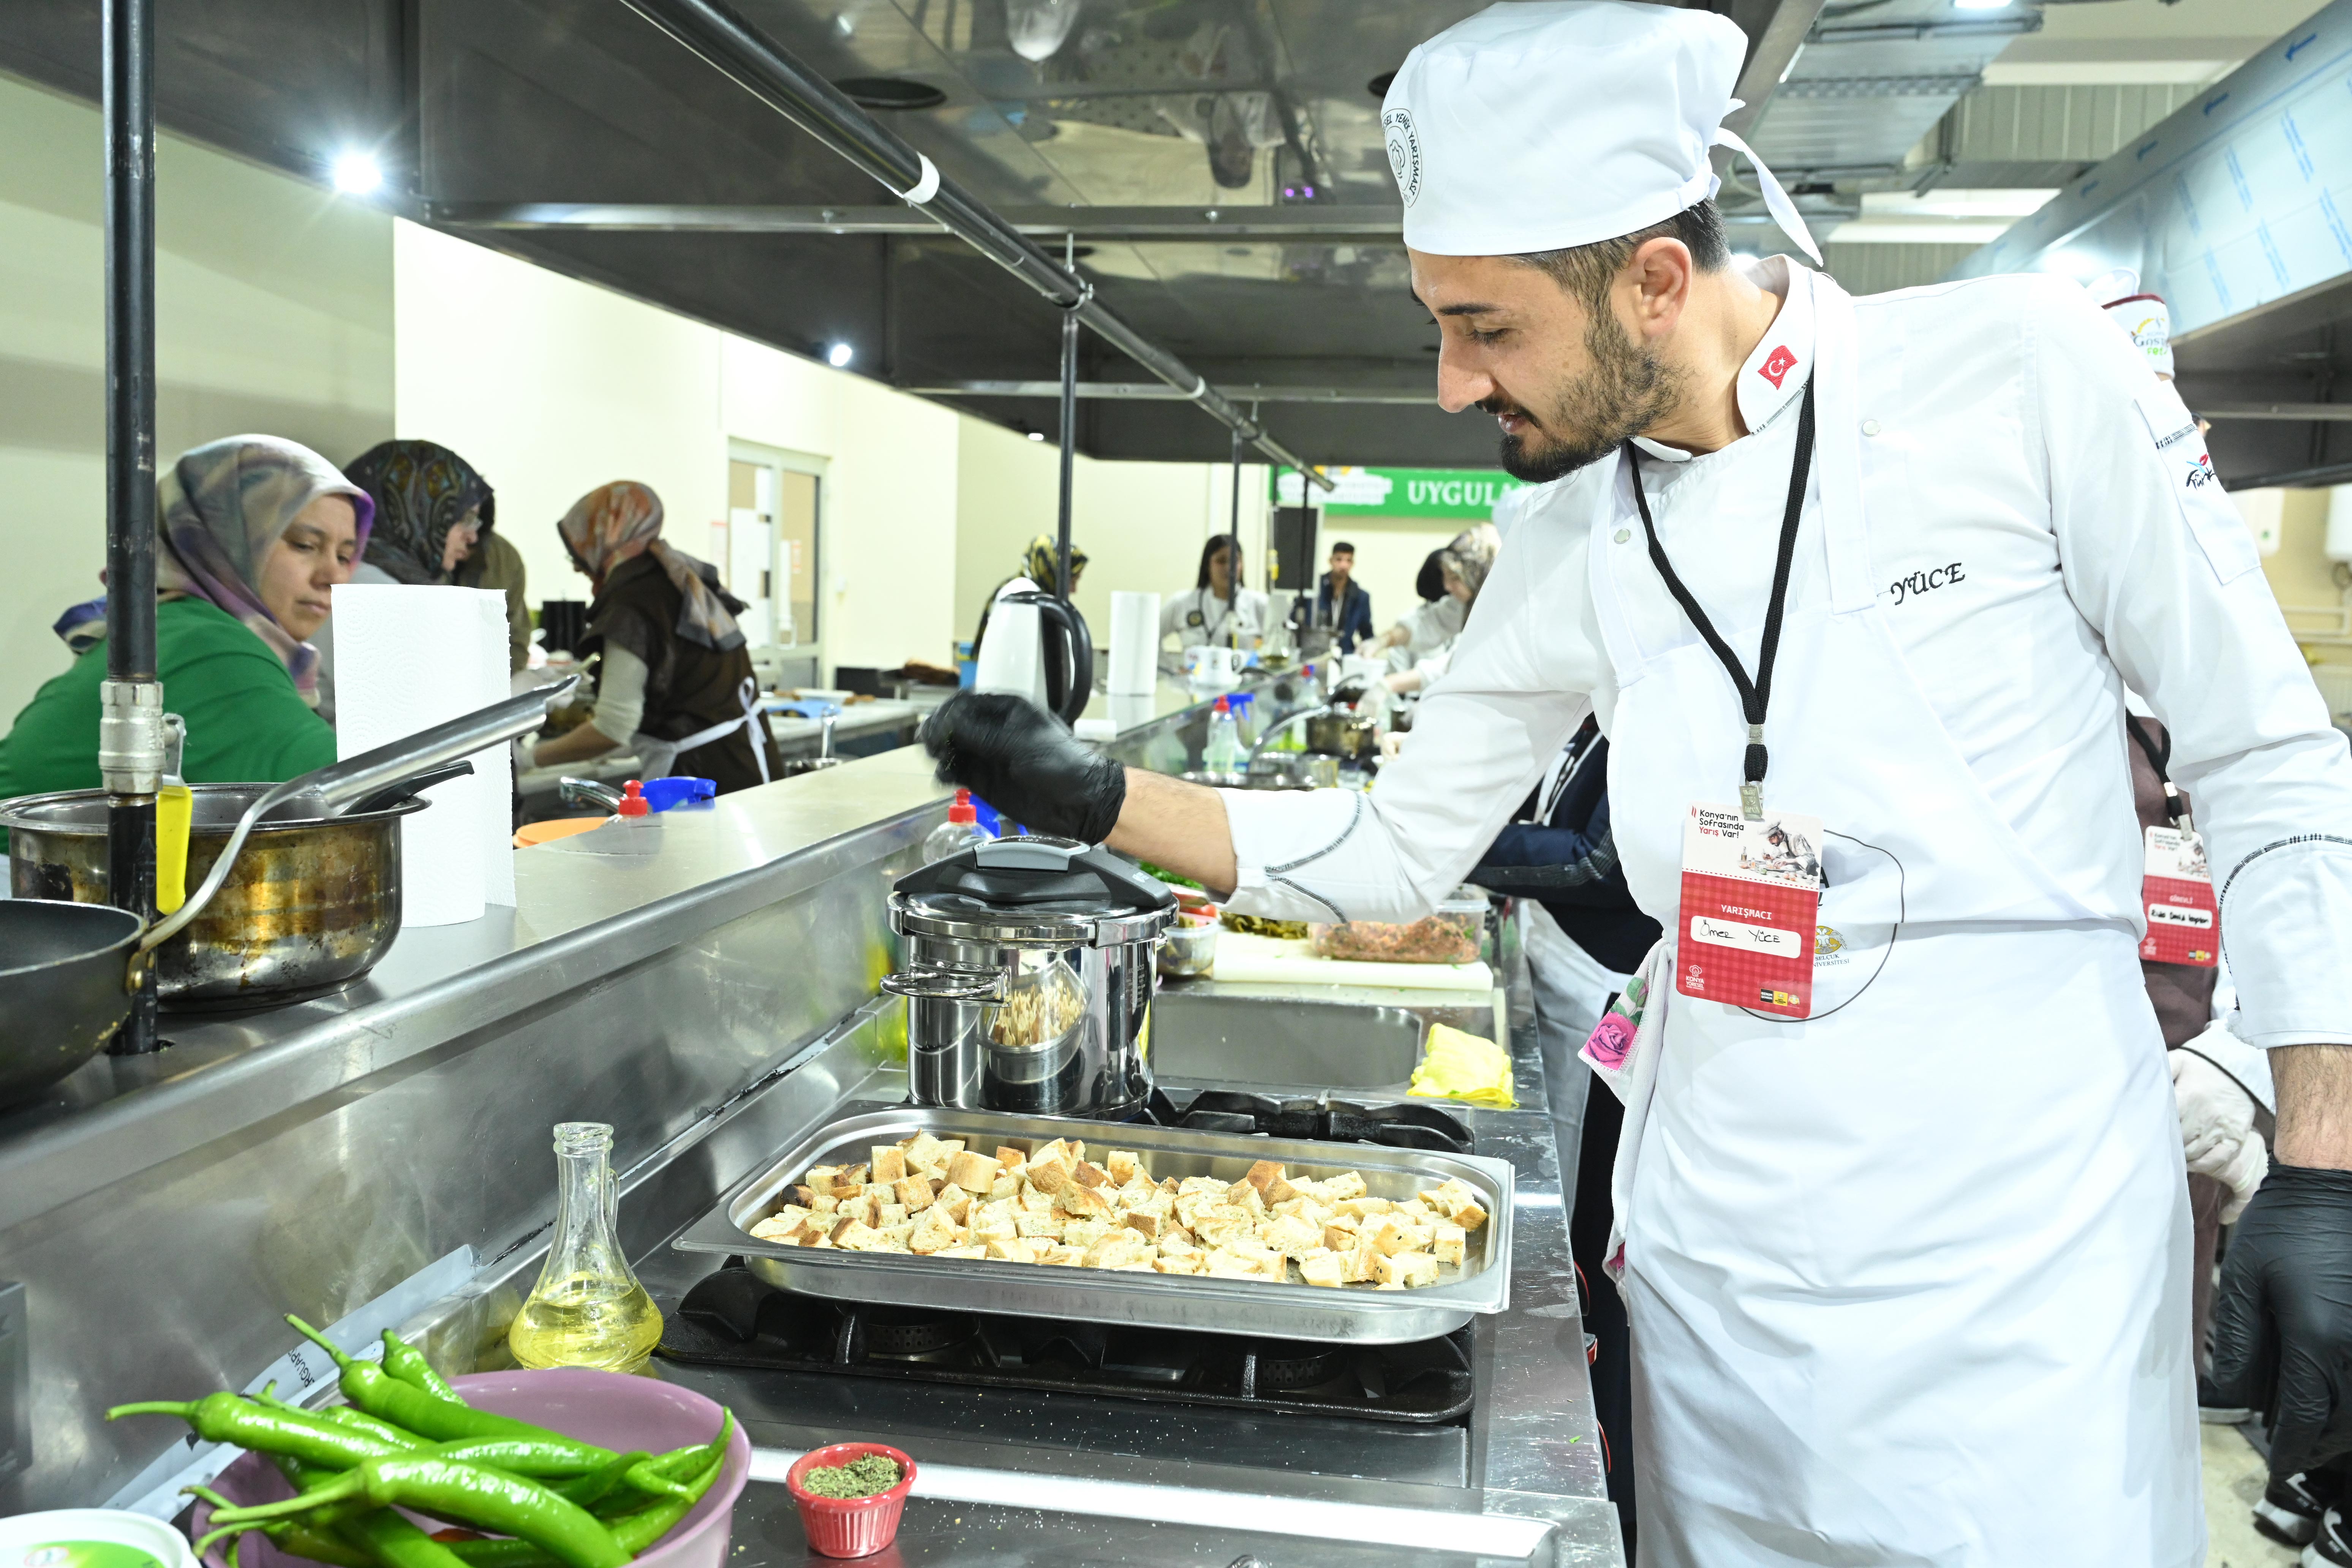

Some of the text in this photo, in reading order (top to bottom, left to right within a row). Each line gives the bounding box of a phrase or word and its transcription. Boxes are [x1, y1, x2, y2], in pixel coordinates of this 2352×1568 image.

[1396, 113, 1410, 133] YEMEK
[1700, 809, 1738, 821] Konya'nın
[1699, 818, 1744, 831] Sofrasında
[1699, 826, 1739, 838] Yarış Var!
[1721, 904, 1772, 920] YARIŞMACI
[1813, 958, 1849, 967] NİVERSİTESİ
[1686, 975, 1704, 984] KONYA
